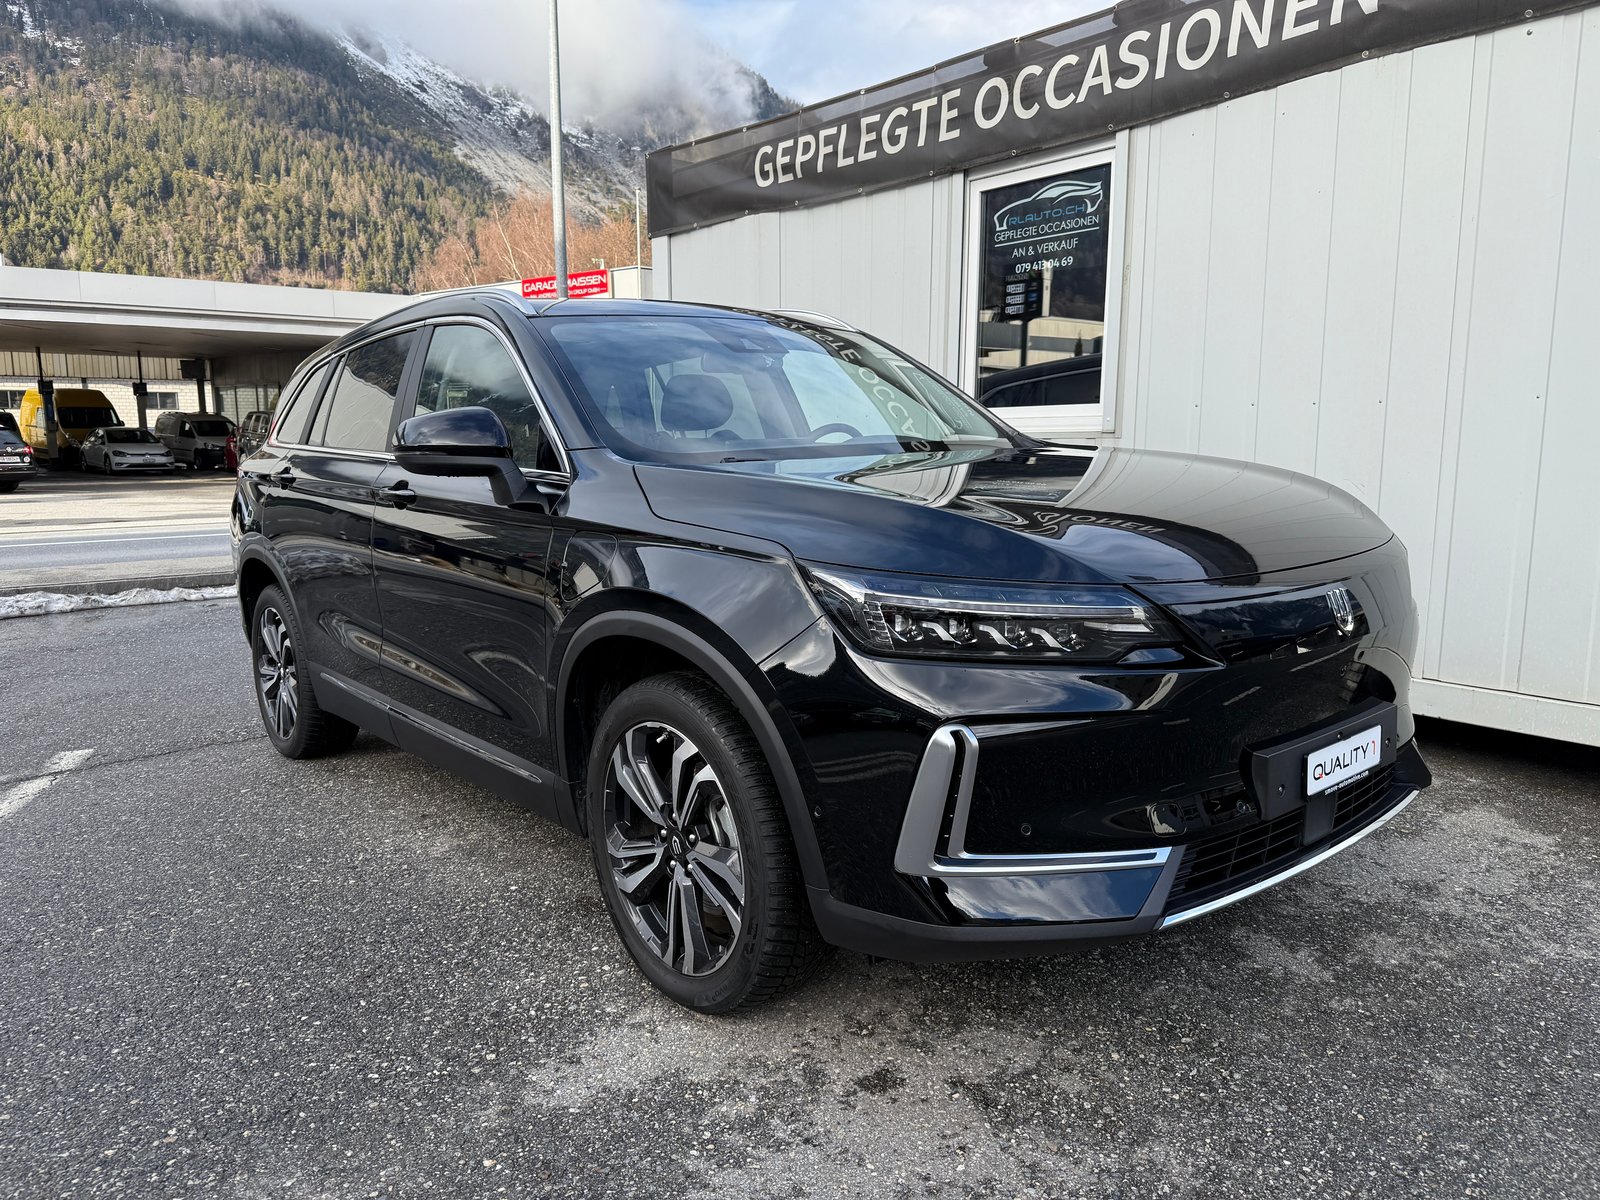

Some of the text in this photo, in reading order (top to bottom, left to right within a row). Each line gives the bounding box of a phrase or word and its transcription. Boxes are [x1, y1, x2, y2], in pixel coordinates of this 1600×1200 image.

[754, 88, 961, 188] GEPFLEGTE
[1008, 204, 1086, 226] RLAUTO.CH
[994, 215, 1099, 242] GEPFLEGTE OCCASIONEN
[1011, 237, 1079, 259] AN & VERKAUF
[1015, 256, 1074, 274] 079 413 04 69
[567, 274, 607, 288] AISSEN
